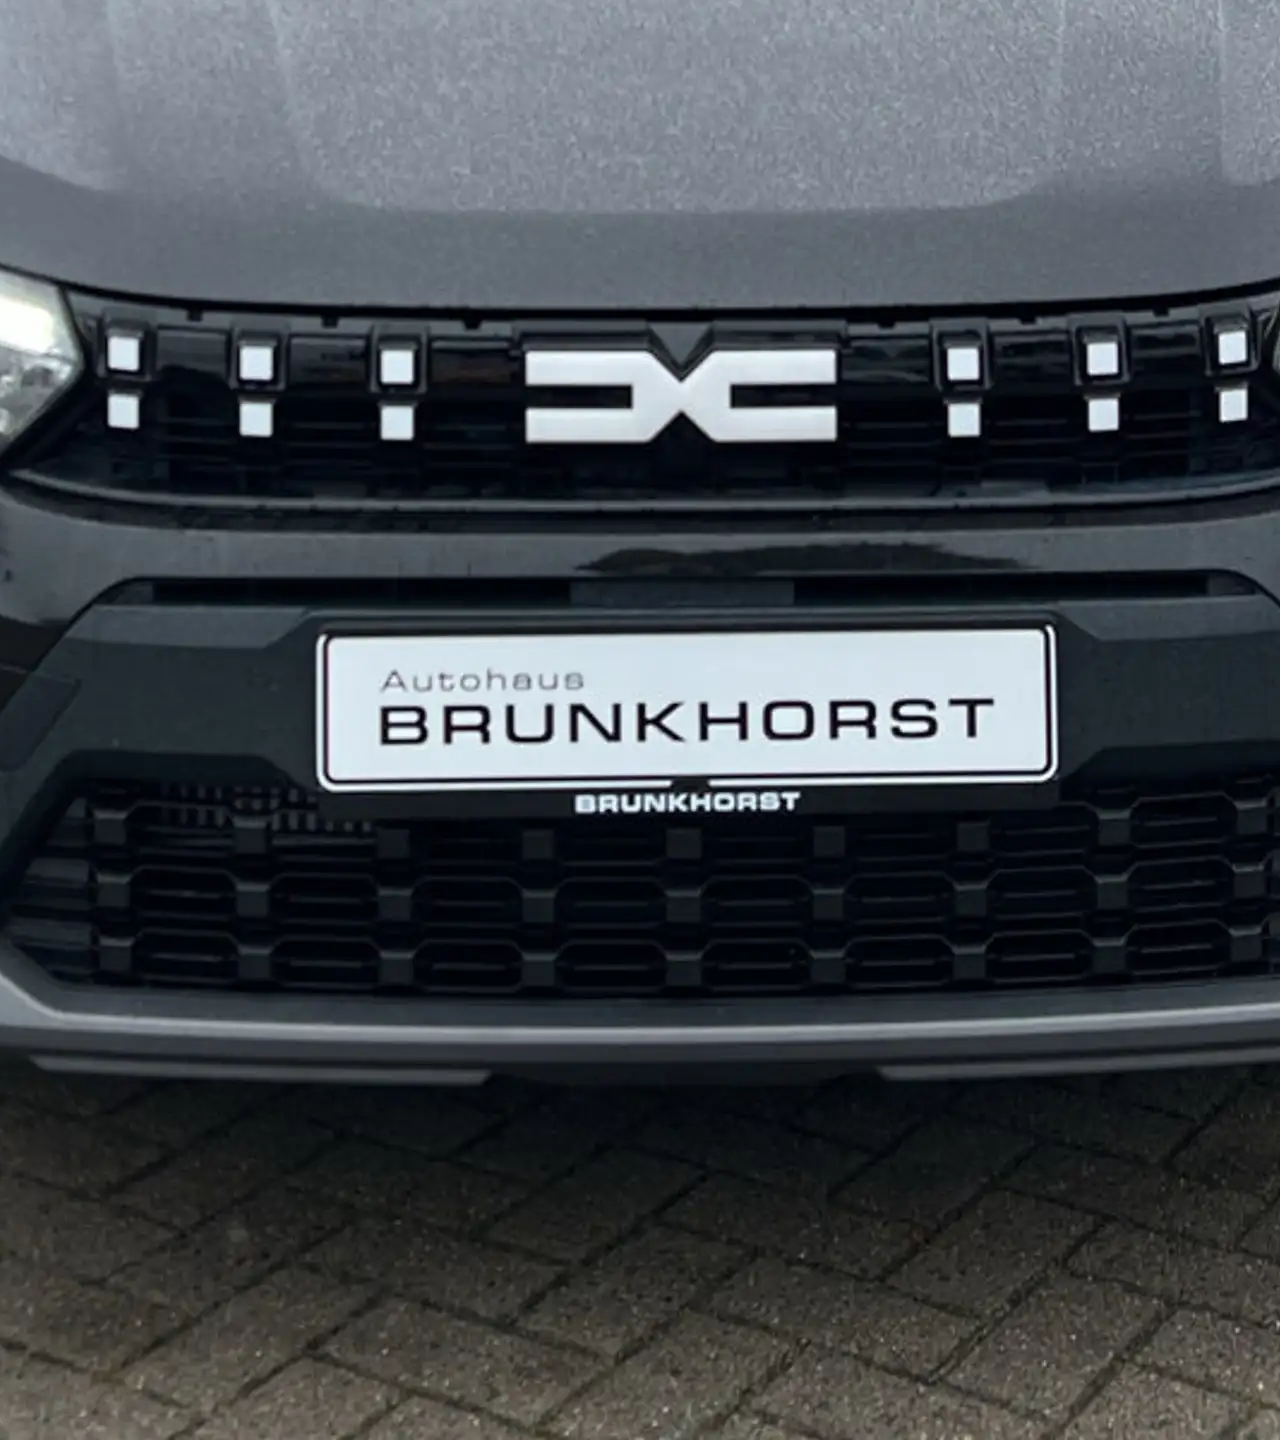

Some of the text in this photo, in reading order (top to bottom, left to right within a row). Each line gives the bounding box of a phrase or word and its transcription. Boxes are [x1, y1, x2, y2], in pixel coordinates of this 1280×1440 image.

[380, 668, 585, 694] Autohaus
[380, 698, 995, 746] BRUNKHORST
[574, 791, 800, 814] BRUNKHORST
